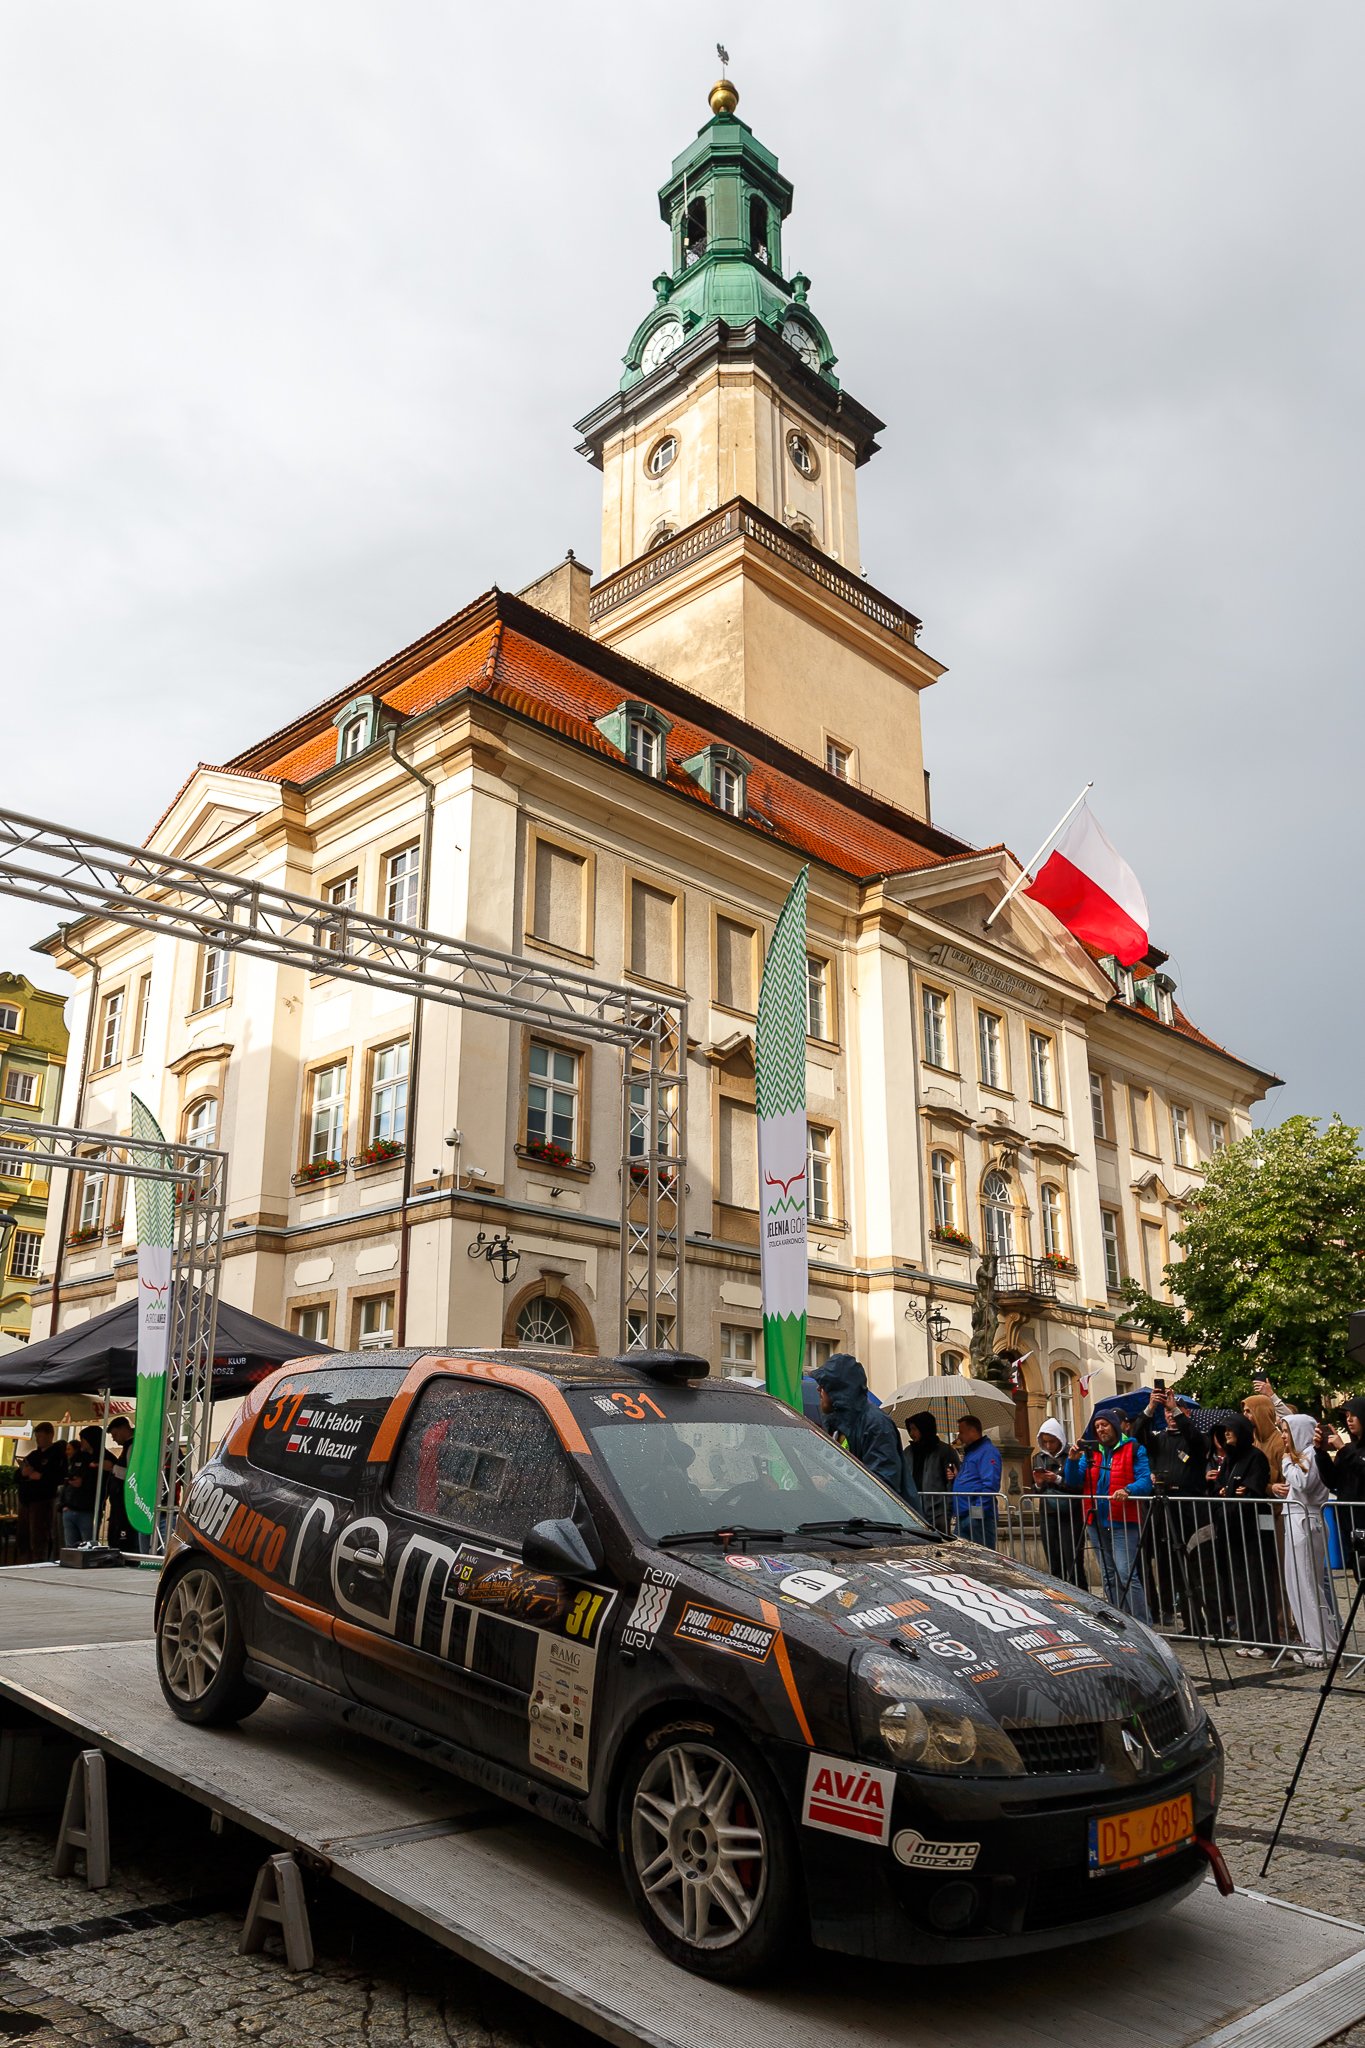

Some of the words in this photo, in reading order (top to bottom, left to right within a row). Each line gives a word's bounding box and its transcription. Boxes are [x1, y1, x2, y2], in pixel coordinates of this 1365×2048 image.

[1006, 974, 1037, 995] DISTORTUS
[767, 1220, 790, 1238] JELENIA
[263, 1383, 309, 1432] 31
[611, 1392, 667, 1419] 31
[309, 1410, 364, 1434] M.Hałoń
[298, 1435, 313, 1455] K.
[314, 1437, 358, 1460] Mazur
[183, 1475, 287, 1573] PROFIAUTO
[643, 1566, 682, 1588] remi
[866, 1558, 955, 1577] remi
[790, 1575, 826, 1592] 31
[564, 1590, 604, 1639] 31
[846, 1599, 931, 1629] PROFIAUTO
[679, 1625, 708, 1637] A-TECH
[707, 1633, 766, 1656] MOTORSPORT
[558, 1648, 581, 1666] AMG
[954, 1658, 999, 1678] emage
[971, 1669, 999, 1683] GROUP
[1102, 1817, 1131, 1862] D5
[1151, 1798, 1188, 1847] 6895
[916, 1843, 979, 1856] MOTO
[912, 1857, 973, 1867] WIZJA
